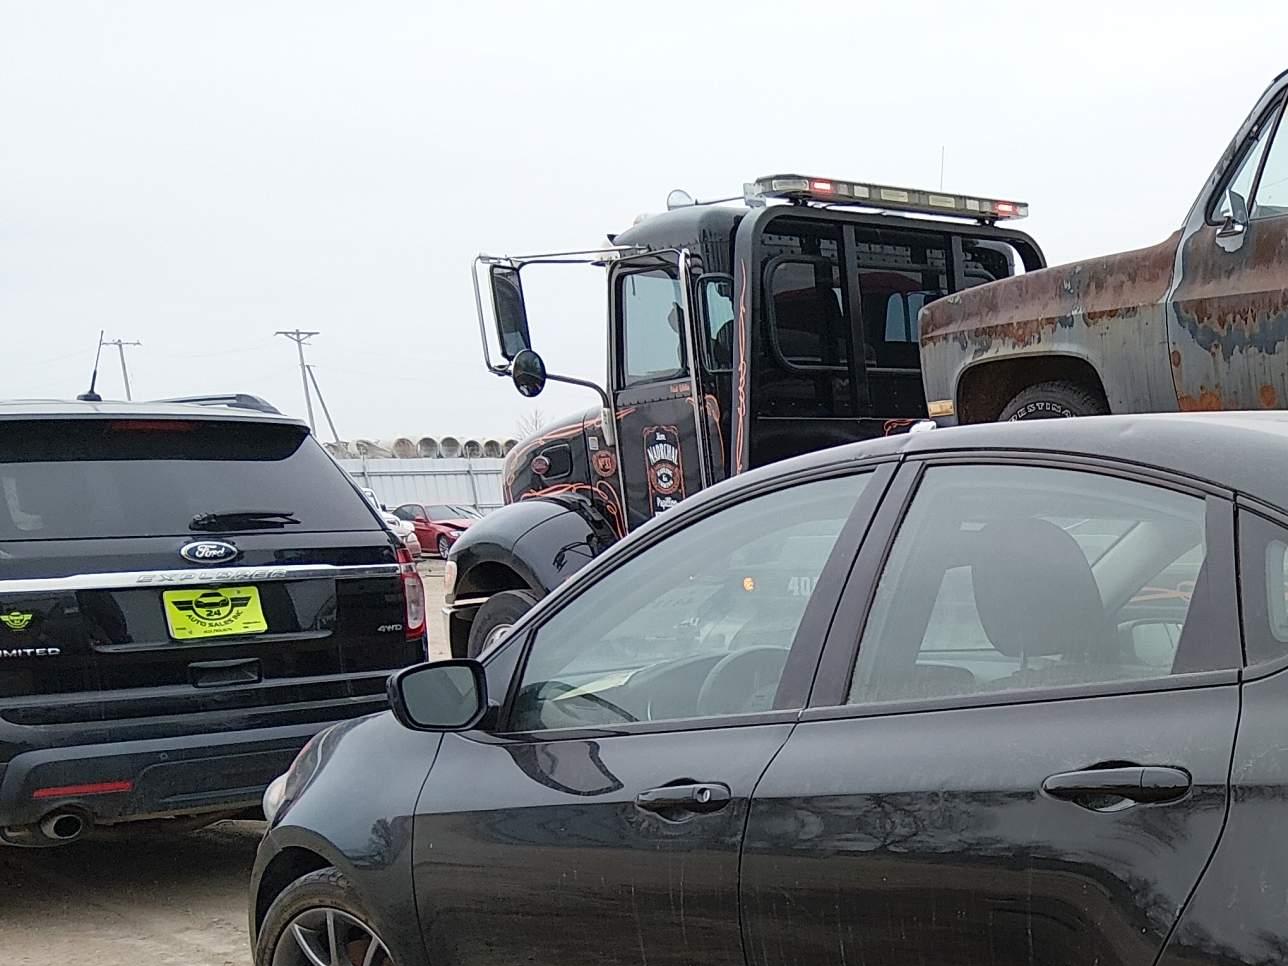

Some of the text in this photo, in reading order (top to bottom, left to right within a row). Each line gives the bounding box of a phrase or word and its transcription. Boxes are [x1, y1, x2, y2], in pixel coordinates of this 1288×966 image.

[195, 544, 226, 558] Ford
[136, 569, 288, 583] EXPLORER
[205, 609, 222, 617] 24
[186, 614, 207, 628] AUTO
[207, 618, 234, 628] SALES
[377, 624, 403, 632] 4WD
